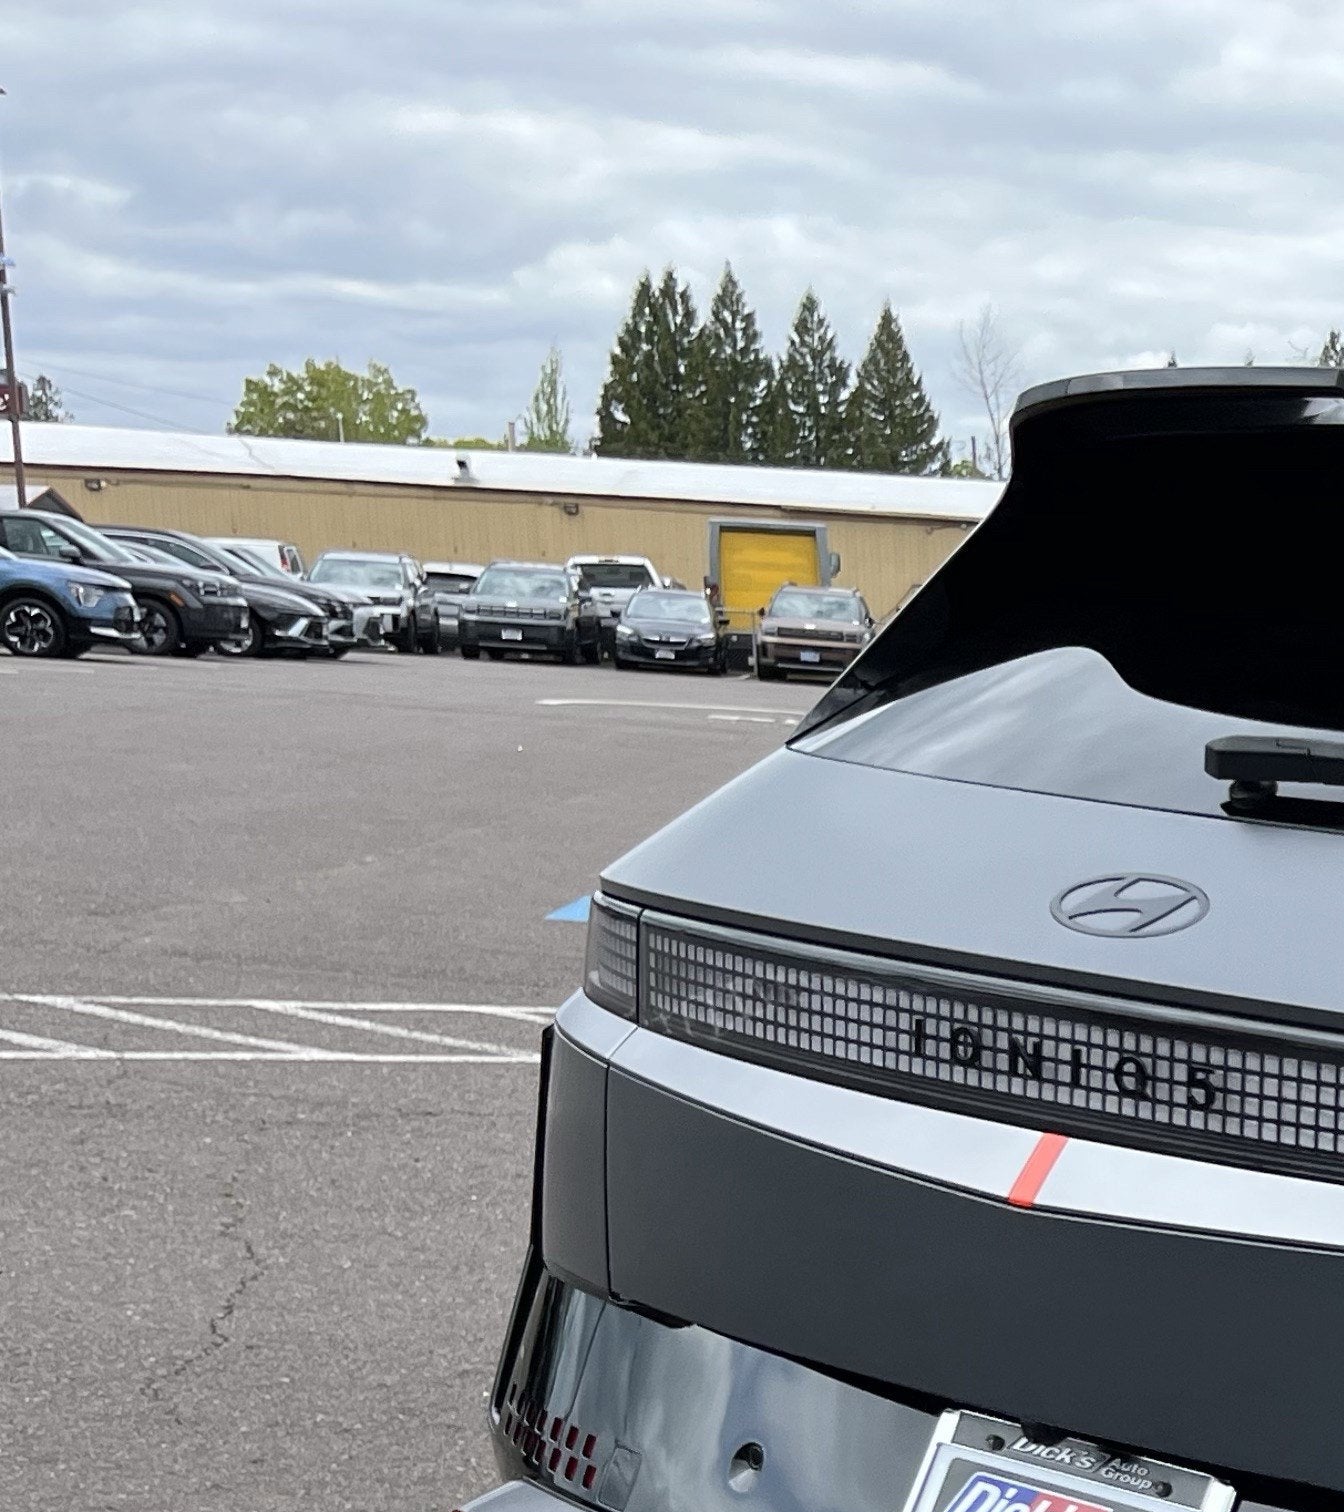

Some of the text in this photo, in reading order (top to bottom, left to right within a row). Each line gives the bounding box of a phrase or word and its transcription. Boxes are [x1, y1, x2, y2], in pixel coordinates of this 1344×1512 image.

[914, 1018, 1217, 1110] IONIQ 5
[1101, 1467, 1153, 1491] Group
[1107, 1458, 1150, 1476] Auto
